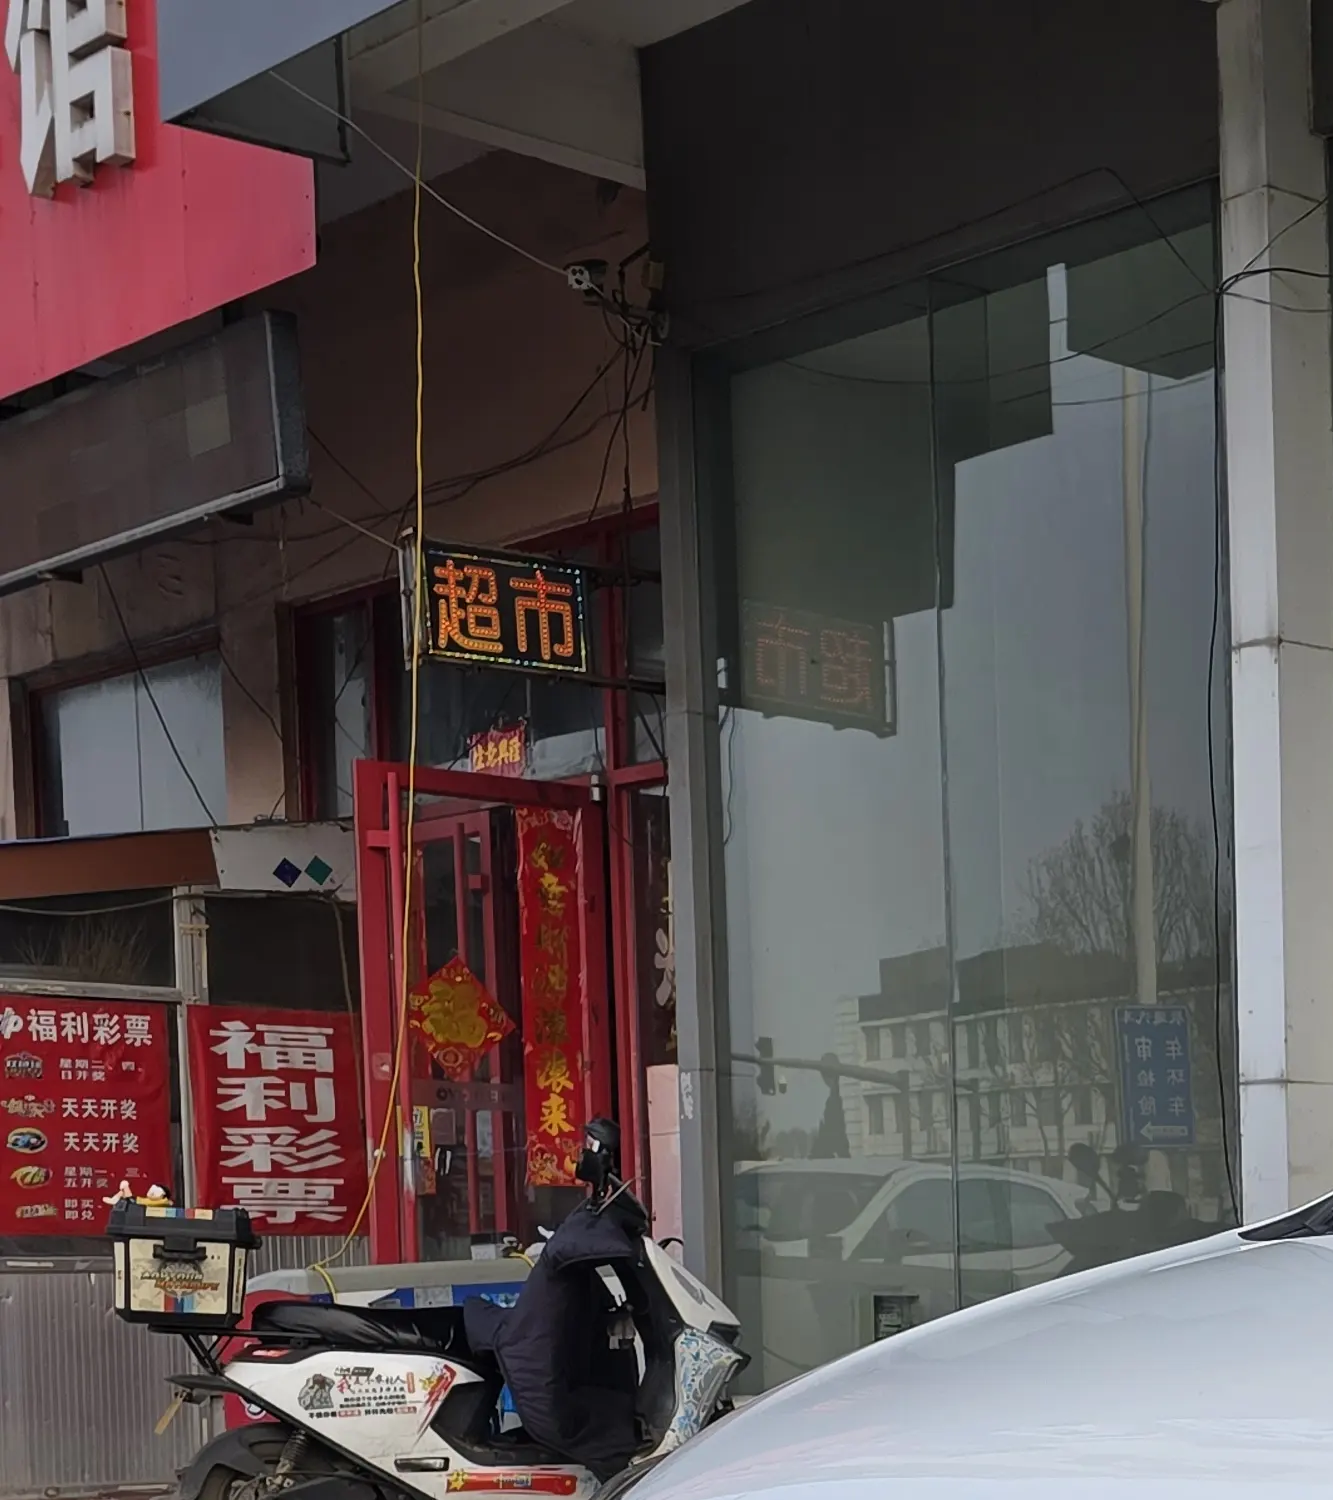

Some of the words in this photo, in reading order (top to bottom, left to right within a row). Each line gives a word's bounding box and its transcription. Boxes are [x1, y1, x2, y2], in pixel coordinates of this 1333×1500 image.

[433, 558, 573, 660] 超市
[27, 1007, 154, 1047] 福利彩票
[62, 1097, 138, 1122] 天天开奖
[209, 1020, 348, 1225] 福利彩票
[63, 1131, 139, 1155] 天天开奖
